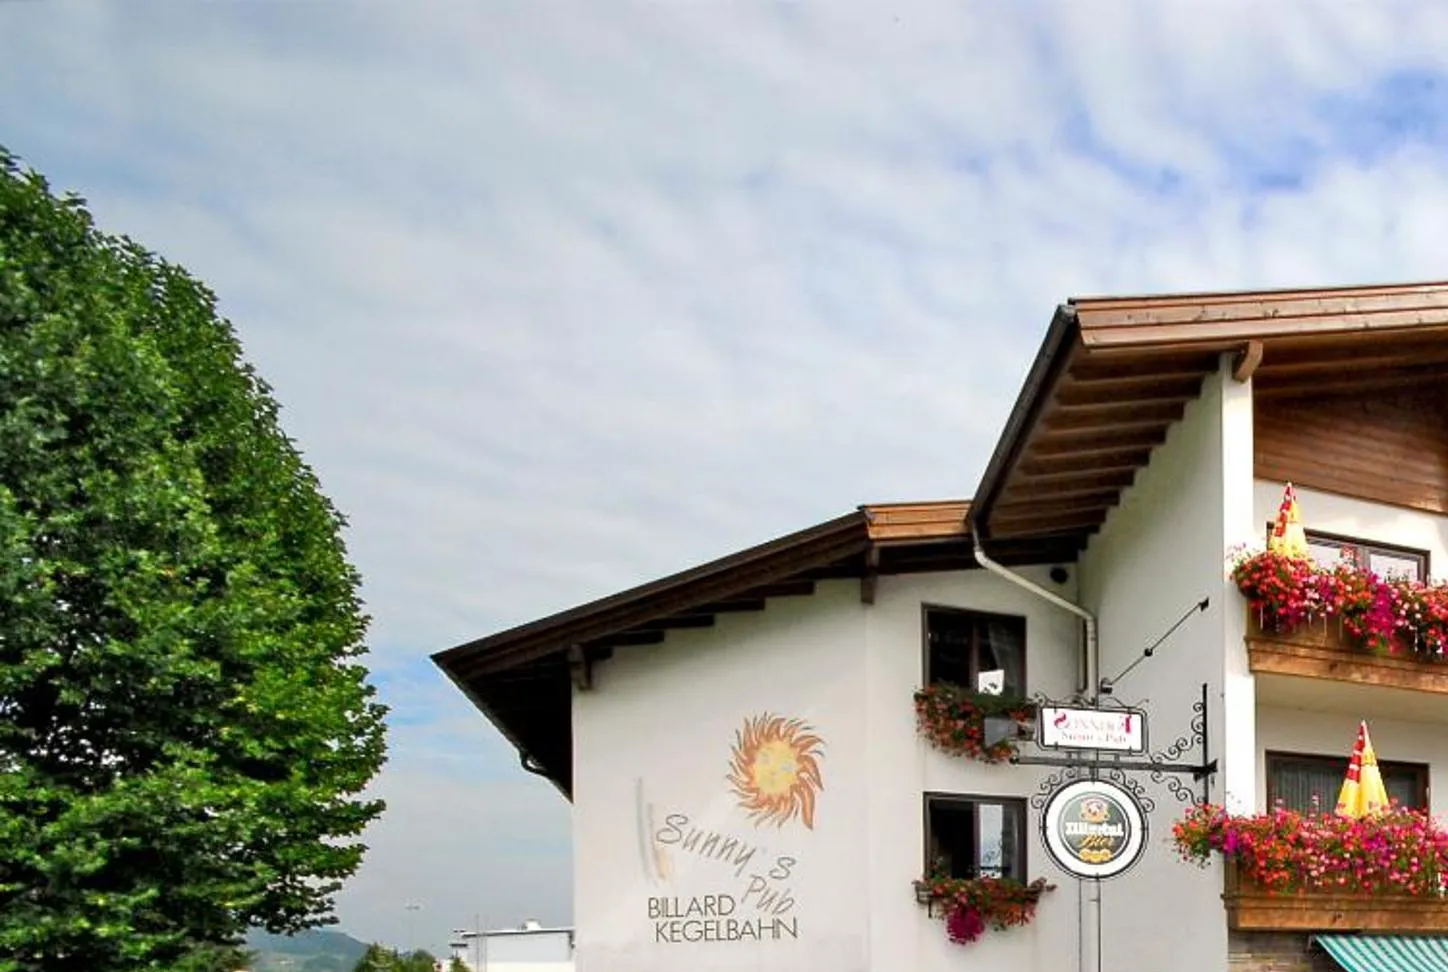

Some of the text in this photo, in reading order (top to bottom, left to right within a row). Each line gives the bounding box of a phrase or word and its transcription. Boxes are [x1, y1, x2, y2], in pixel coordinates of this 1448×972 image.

[648, 894, 737, 919] BILLARD
[740, 873, 795, 916] Pub
[655, 917, 799, 944] KEGELBAHN
